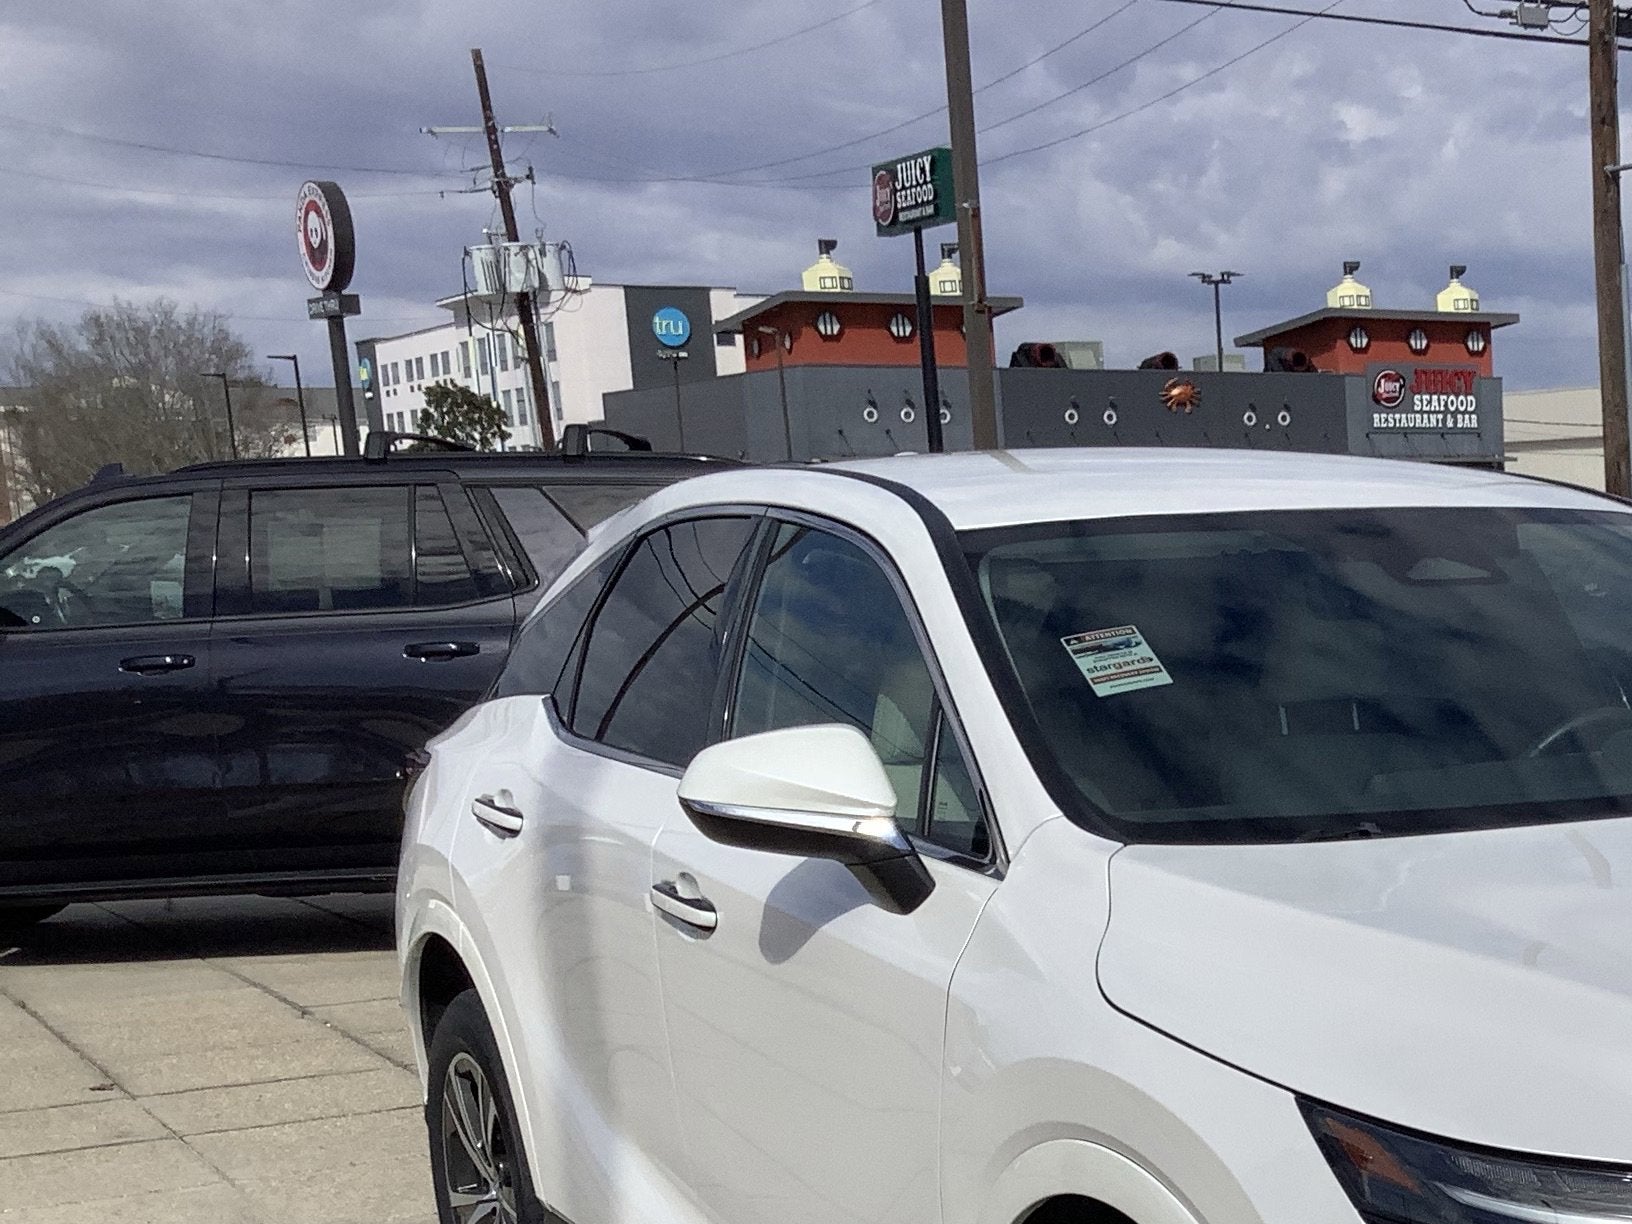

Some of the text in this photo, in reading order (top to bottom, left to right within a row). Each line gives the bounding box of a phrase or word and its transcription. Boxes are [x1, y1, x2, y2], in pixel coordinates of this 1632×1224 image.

[895, 155, 932, 190] JUICY
[896, 183, 934, 209] SEAFOOD
[654, 316, 683, 335] tru
[1409, 368, 1475, 394] JUICY
[1413, 394, 1476, 412] SEAFOOD
[1373, 413, 1479, 428] RESTAURANT & BAR
[1084, 628, 1133, 641] ATTENTION
